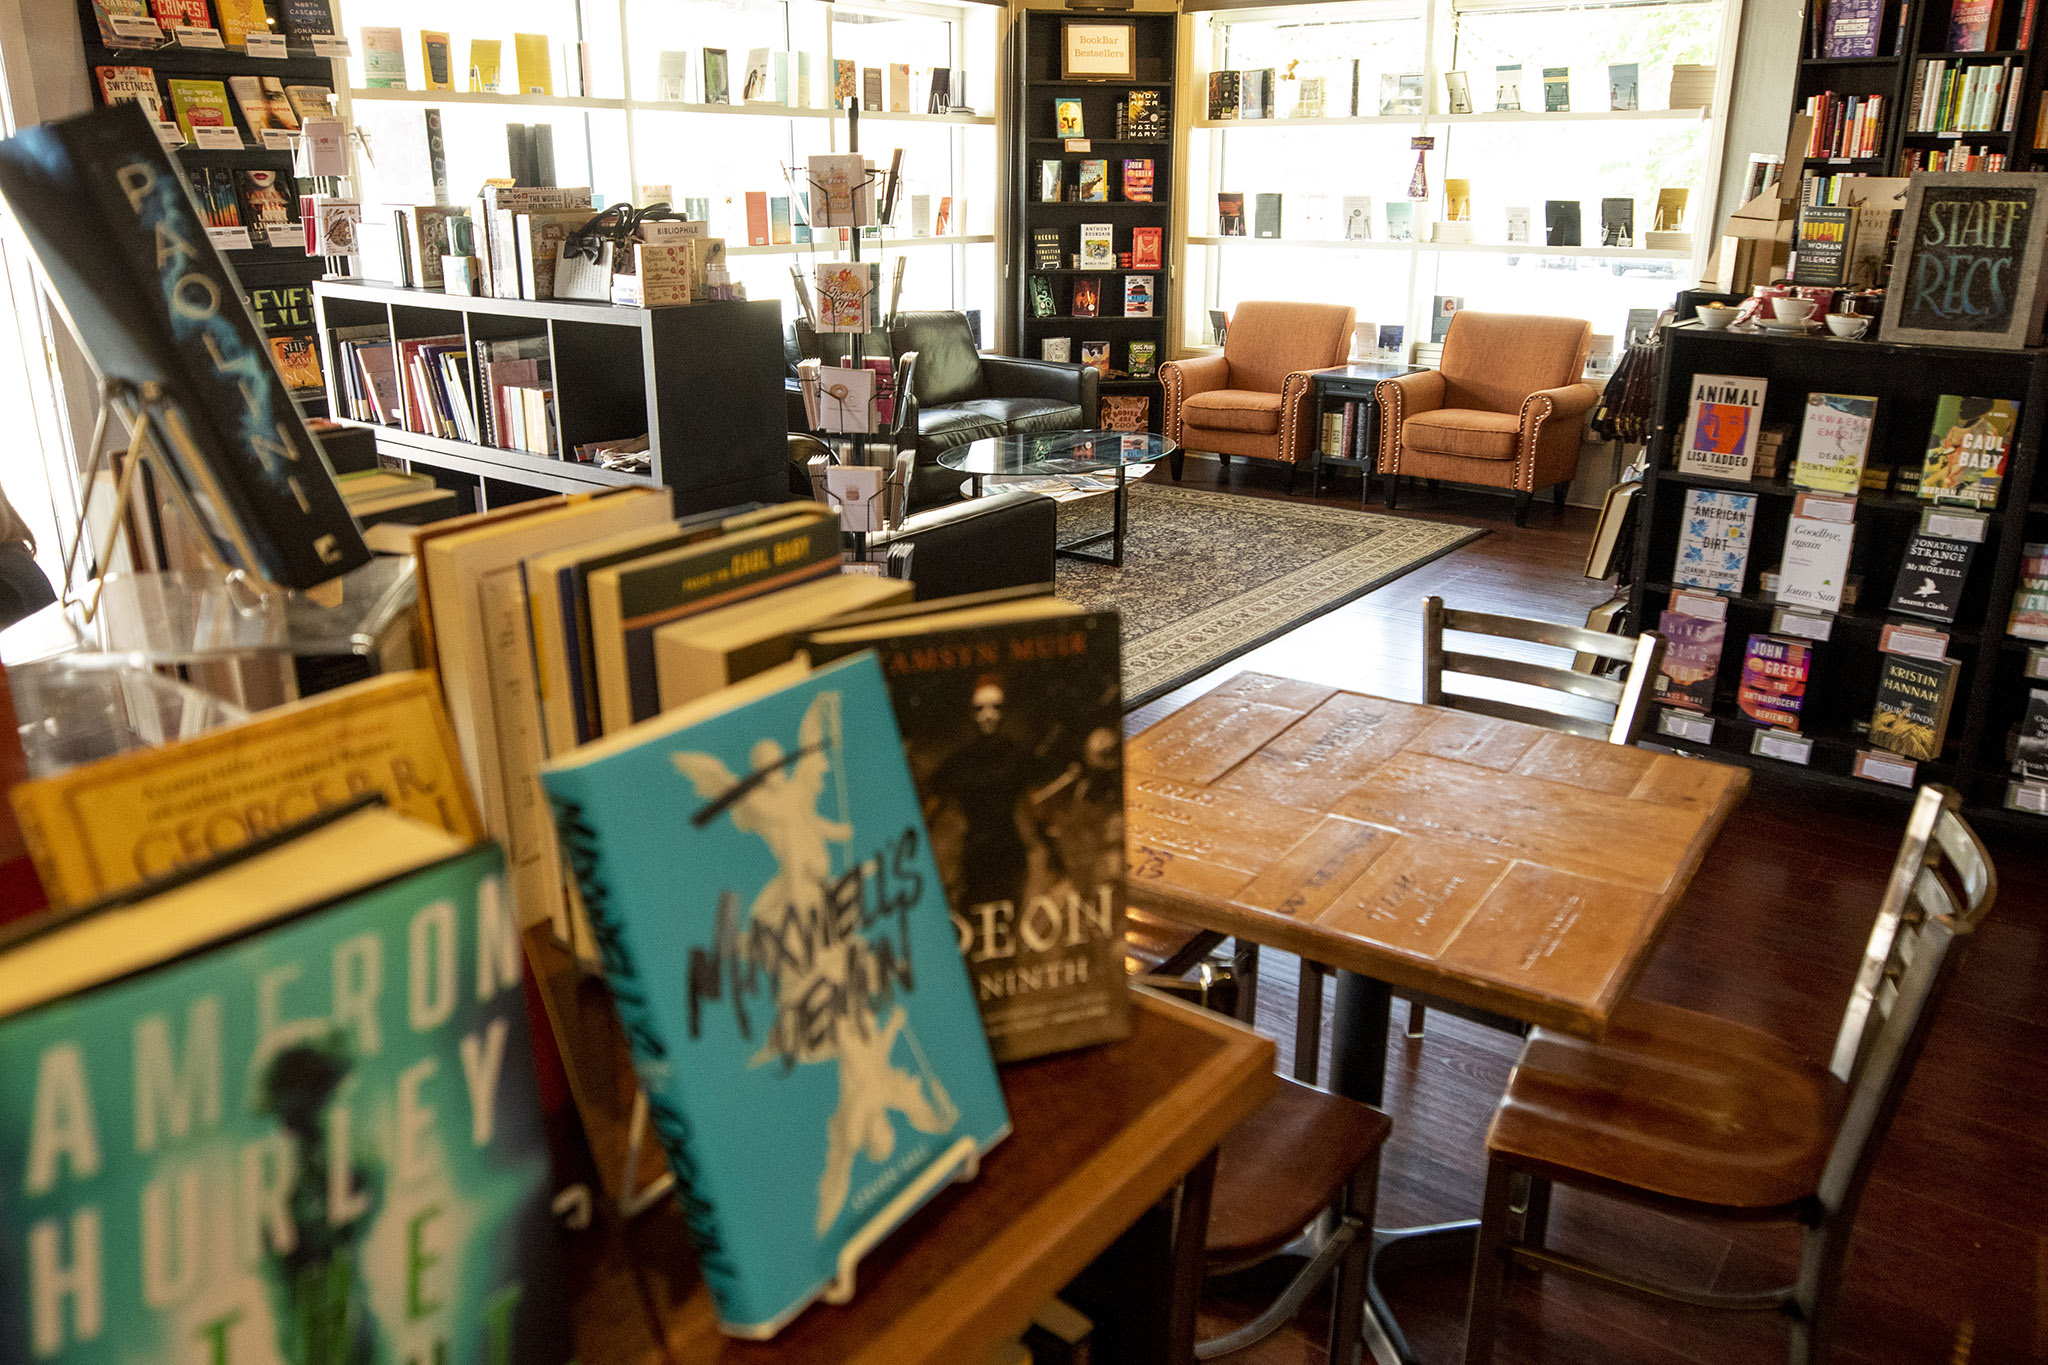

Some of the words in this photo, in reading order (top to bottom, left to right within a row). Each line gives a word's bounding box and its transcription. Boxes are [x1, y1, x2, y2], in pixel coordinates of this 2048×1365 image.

[1079, 35, 1119, 45] BookBar
[1074, 48, 1124, 58] Bestsellers
[106, 81, 155, 92] SWEETNESS
[196, 89, 214, 97] way
[657, 226, 699, 235] BIBLIOPHILE
[1924, 199, 2028, 249] STAFF
[1807, 242, 1842, 250] WOMAN
[1800, 256, 1837, 264] SILENCE
[826, 283, 862, 300] Thank
[1912, 252, 2013, 319] RECS
[833, 300, 858, 317] You
[282, 342, 306, 353] SHE
[285, 370, 316, 381] SUN
[1696, 384, 1760, 406] ANIMAL
[1810, 413, 1868, 428] AKWAEKE
[1962, 433, 2005, 452] CAUL
[1687, 450, 1708, 462] LISA
[1711, 453, 1749, 467] TADDEO
[1819, 451, 1845, 461] DEAR
[1958, 452, 2003, 470] BABY
[1801, 462, 1859, 476] SENTHURAN
[1922, 486, 1957, 496] MORGAN
[1961, 490, 1995, 501] JERKINS
[1695, 506, 1747, 522] AMERICAN
[1703, 536, 1729, 551] DIRT
[1792, 539, 1822, 551] again
[1913, 538, 1969, 553] JONATHAN
[1909, 545, 1966, 562] STRANGE
[1919, 565, 1962, 577] NORRELL
[1817, 590, 1837, 602] Sun
[1926, 601, 1949, 611] Clarke
[1751, 642, 1783, 660] JOHN
[1764, 661, 1804, 679] GREEN
[1890, 665, 1939, 688] KRISTIN
[1773, 682, 1789, 692] THE
[1884, 678, 1939, 703] HANNAH
[1743, 690, 1801, 710] ANTHROPOCENE
[1878, 701, 1903, 715] FOUR
[1905, 710, 1935, 726] WINDS
[978, 955, 1089, 1001] NINTH
